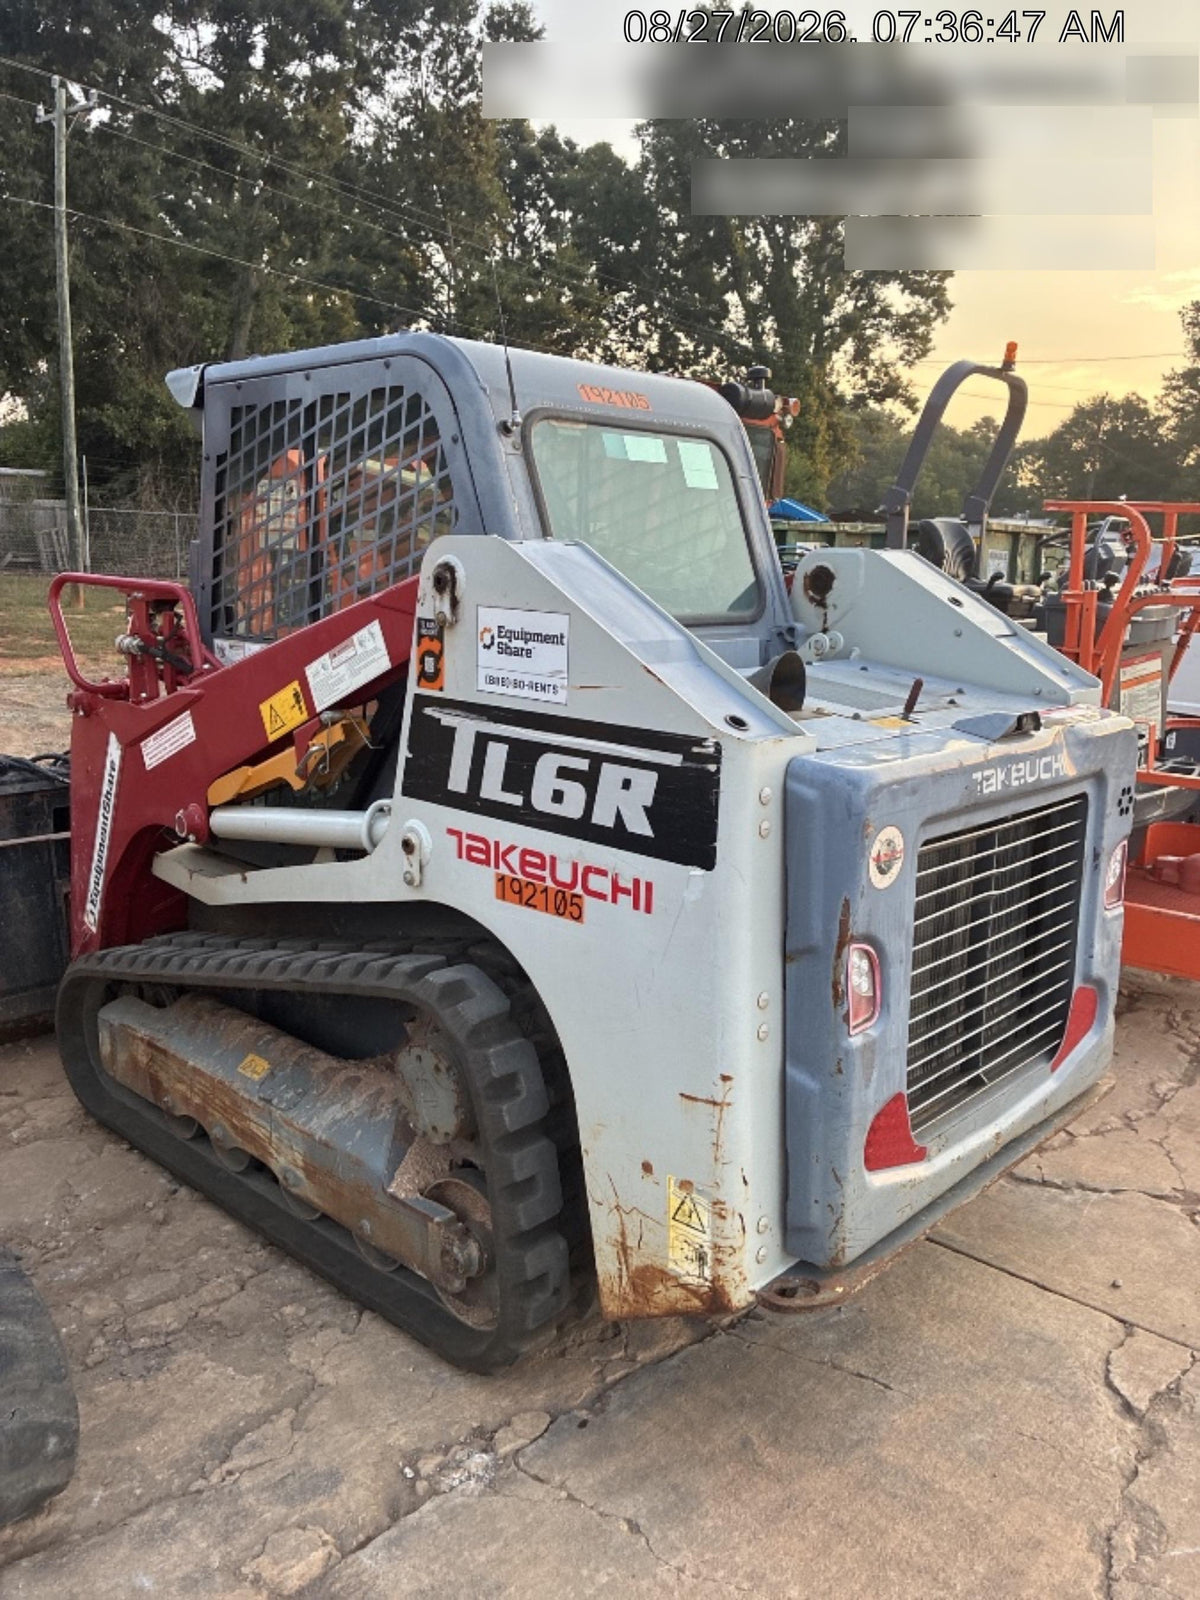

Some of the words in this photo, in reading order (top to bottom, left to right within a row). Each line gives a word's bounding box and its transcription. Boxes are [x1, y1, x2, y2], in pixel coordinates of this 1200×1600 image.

[579, 383, 650, 410] 192105
[496, 625, 565, 646] Equipment
[497, 641, 532, 659] Share
[422, 707, 683, 838] TL6R
[972, 754, 1068, 795] TAKEUCH
[496, 875, 583, 922] 192105
